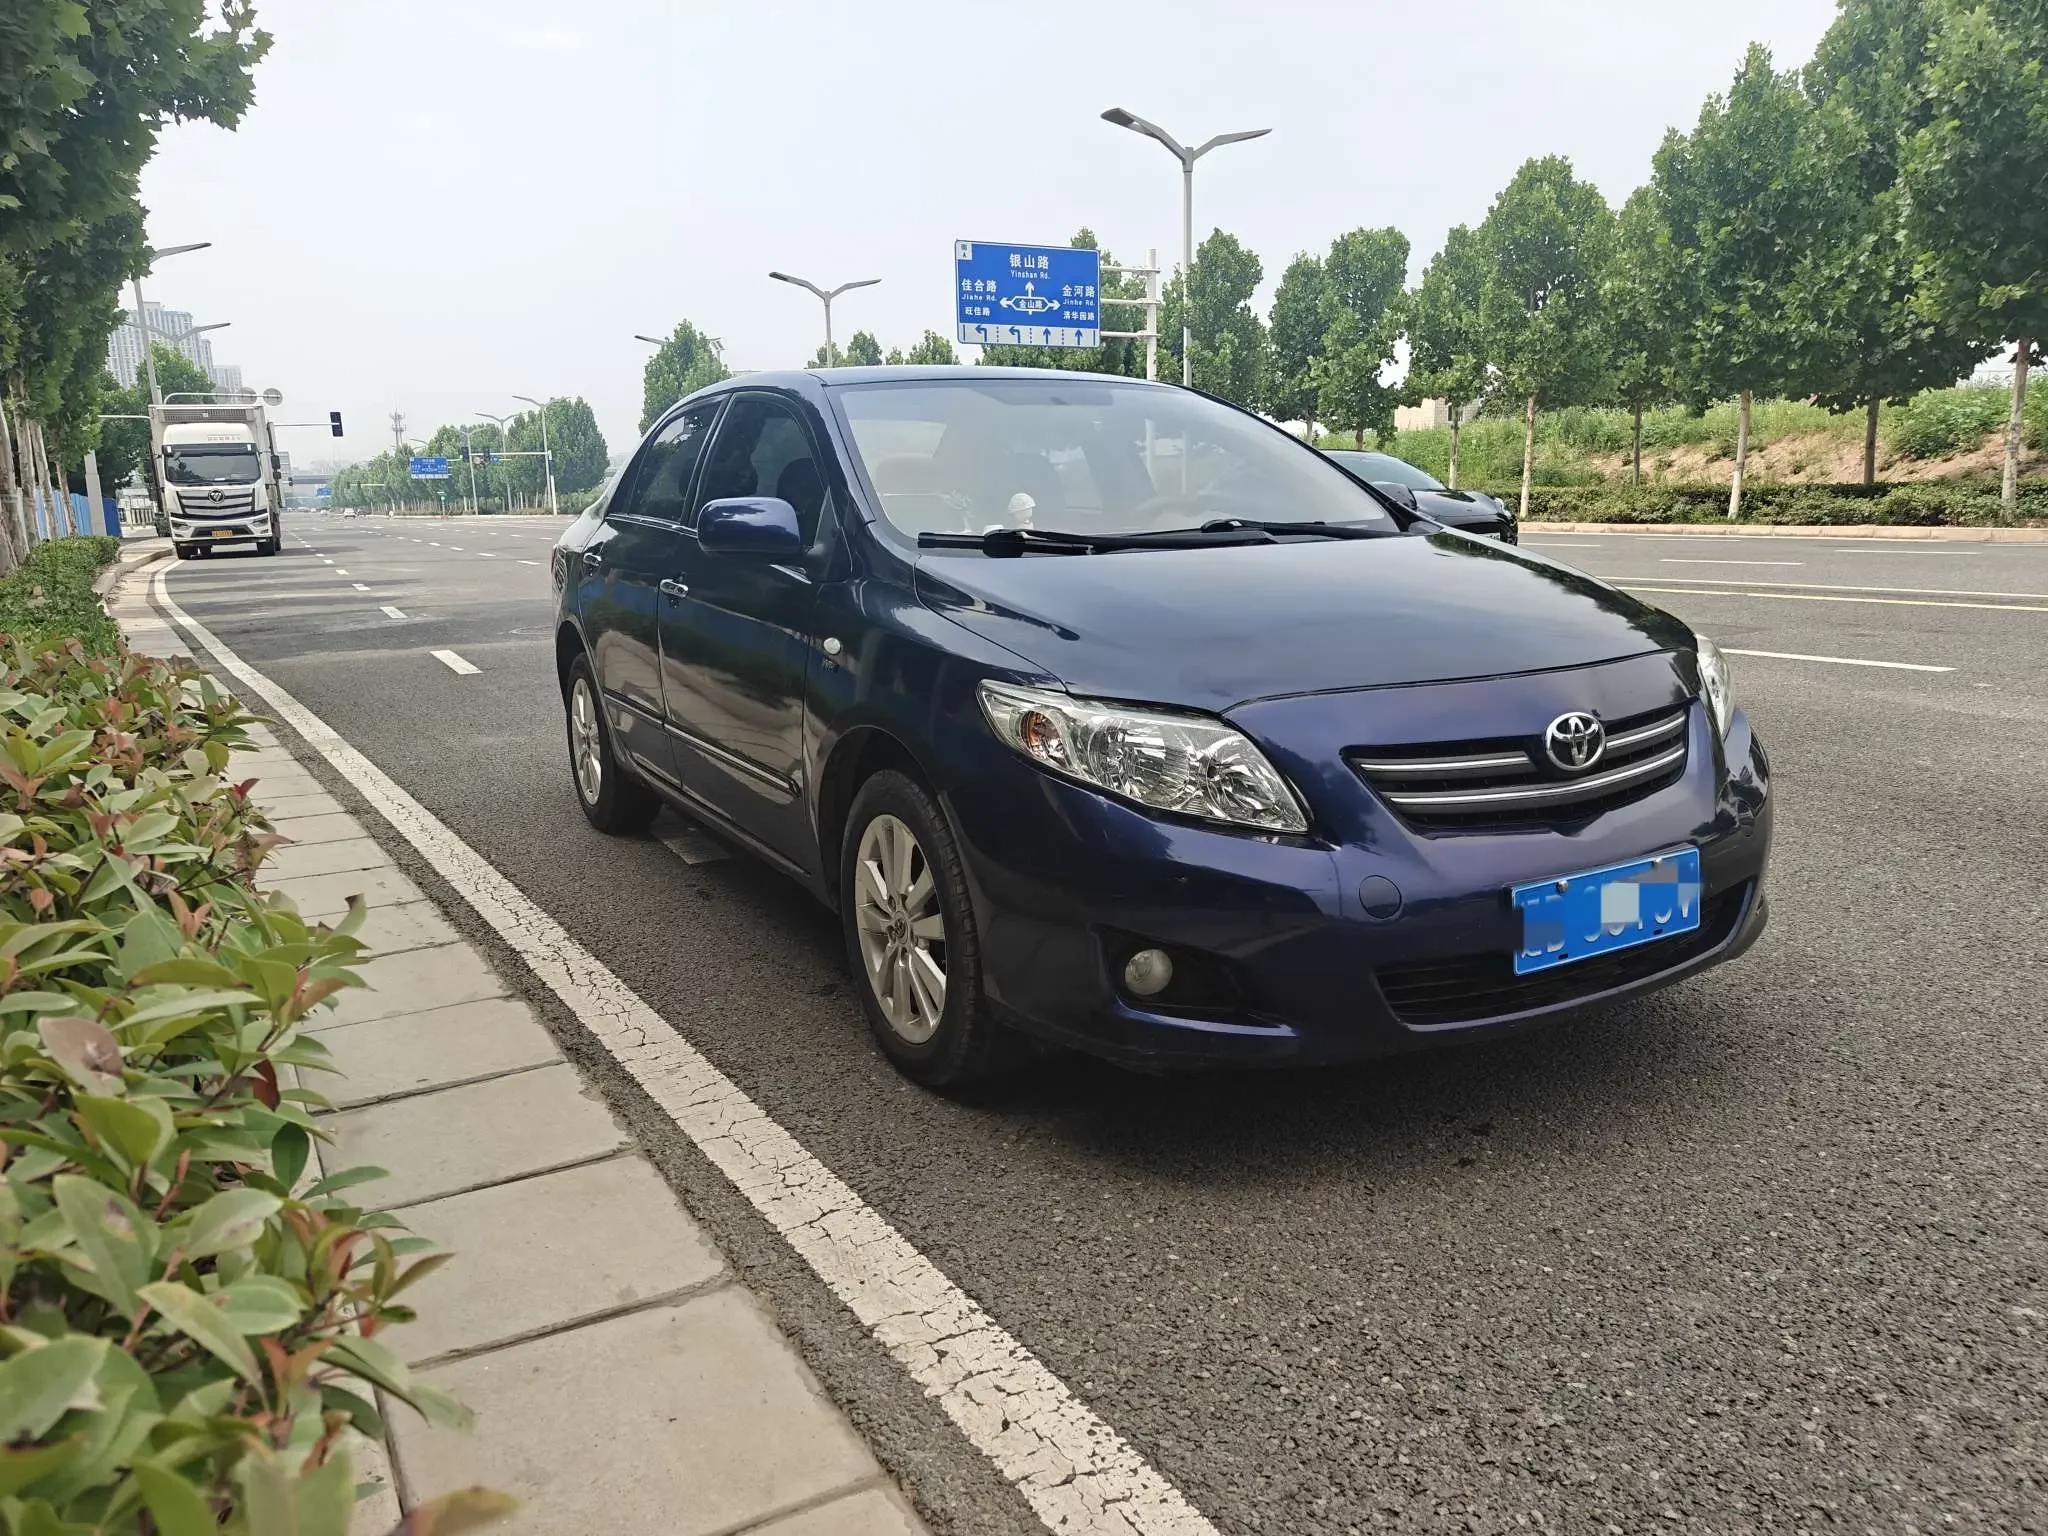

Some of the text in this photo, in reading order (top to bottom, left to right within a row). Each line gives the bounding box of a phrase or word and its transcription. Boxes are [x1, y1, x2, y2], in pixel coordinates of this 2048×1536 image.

[1009, 253, 1049, 270] 银山路
[1010, 269, 1051, 280] Yinshan Rd.
[961, 278, 997, 293] 佳合路
[1062, 284, 1096, 298] 金河路
[961, 293, 998, 302] Jiahe Rd.
[1062, 298, 1096, 307] Jinhe Rd.
[1019, 299, 1043, 309] 金山路
